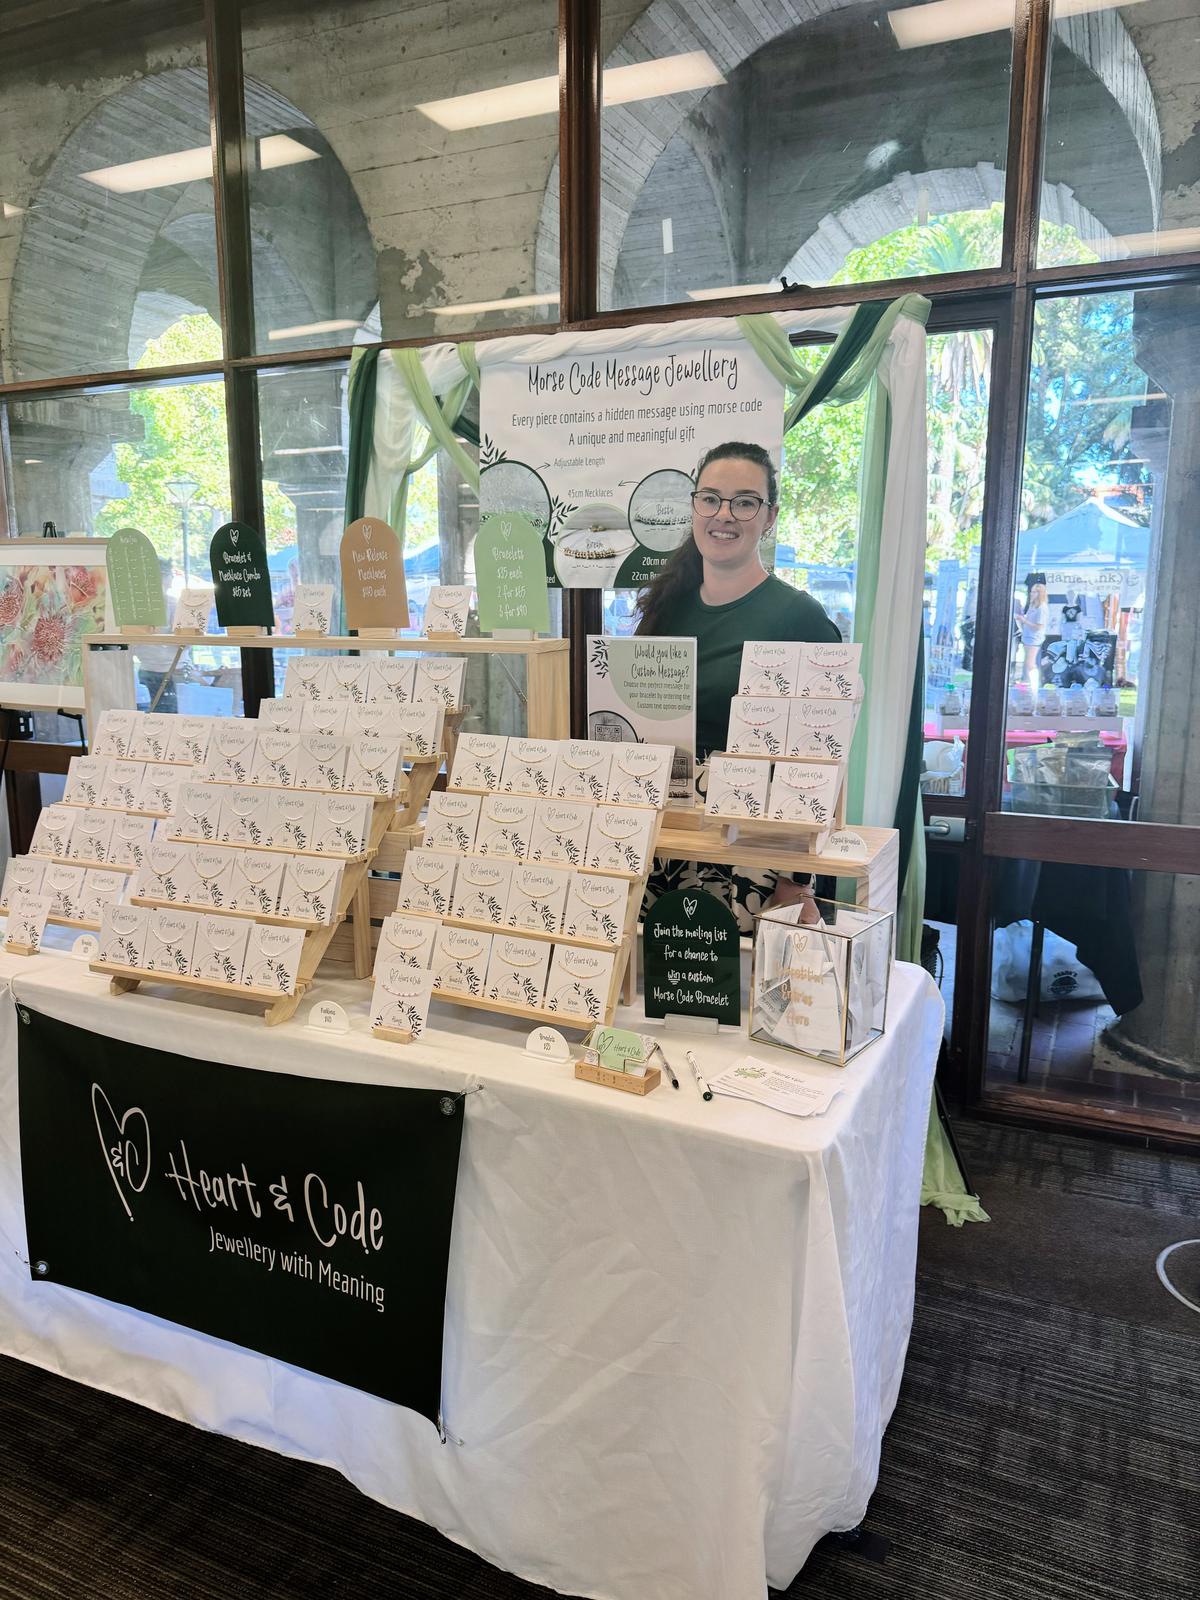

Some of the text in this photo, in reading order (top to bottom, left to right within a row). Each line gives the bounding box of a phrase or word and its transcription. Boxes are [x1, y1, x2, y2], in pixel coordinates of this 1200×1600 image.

[528, 348, 738, 396] Morse Code Message Jewellery
[512, 398, 763, 429] Every piece contains a hidden message using morse code
[568, 425, 695, 447] A unique and meaningful gift
[553, 456, 606, 469] Adjustable Length
[567, 488, 614, 498] 45cm Necklaces
[222, 550, 247, 564] Bracelet
[366, 547, 388, 562] Release
[642, 556, 659, 566] 20cm
[218, 567, 261, 583] Necklace Combo
[631, 571, 649, 581] 22cm
[634, 643, 688, 664] Would you like a
[631, 663, 690, 684] Custom Message?
[653, 922, 728, 945] Join the mailing list
[664, 944, 677, 960] for
[684, 947, 709, 962] chance
[710, 950, 719, 961] to
[667, 969, 714, 983] win a custom
[653, 986, 729, 1006] Morse Code Bracelet
[164, 1139, 385, 1255] Heart & Code
[209, 1225, 386, 1314] Jewellery with Meaning
